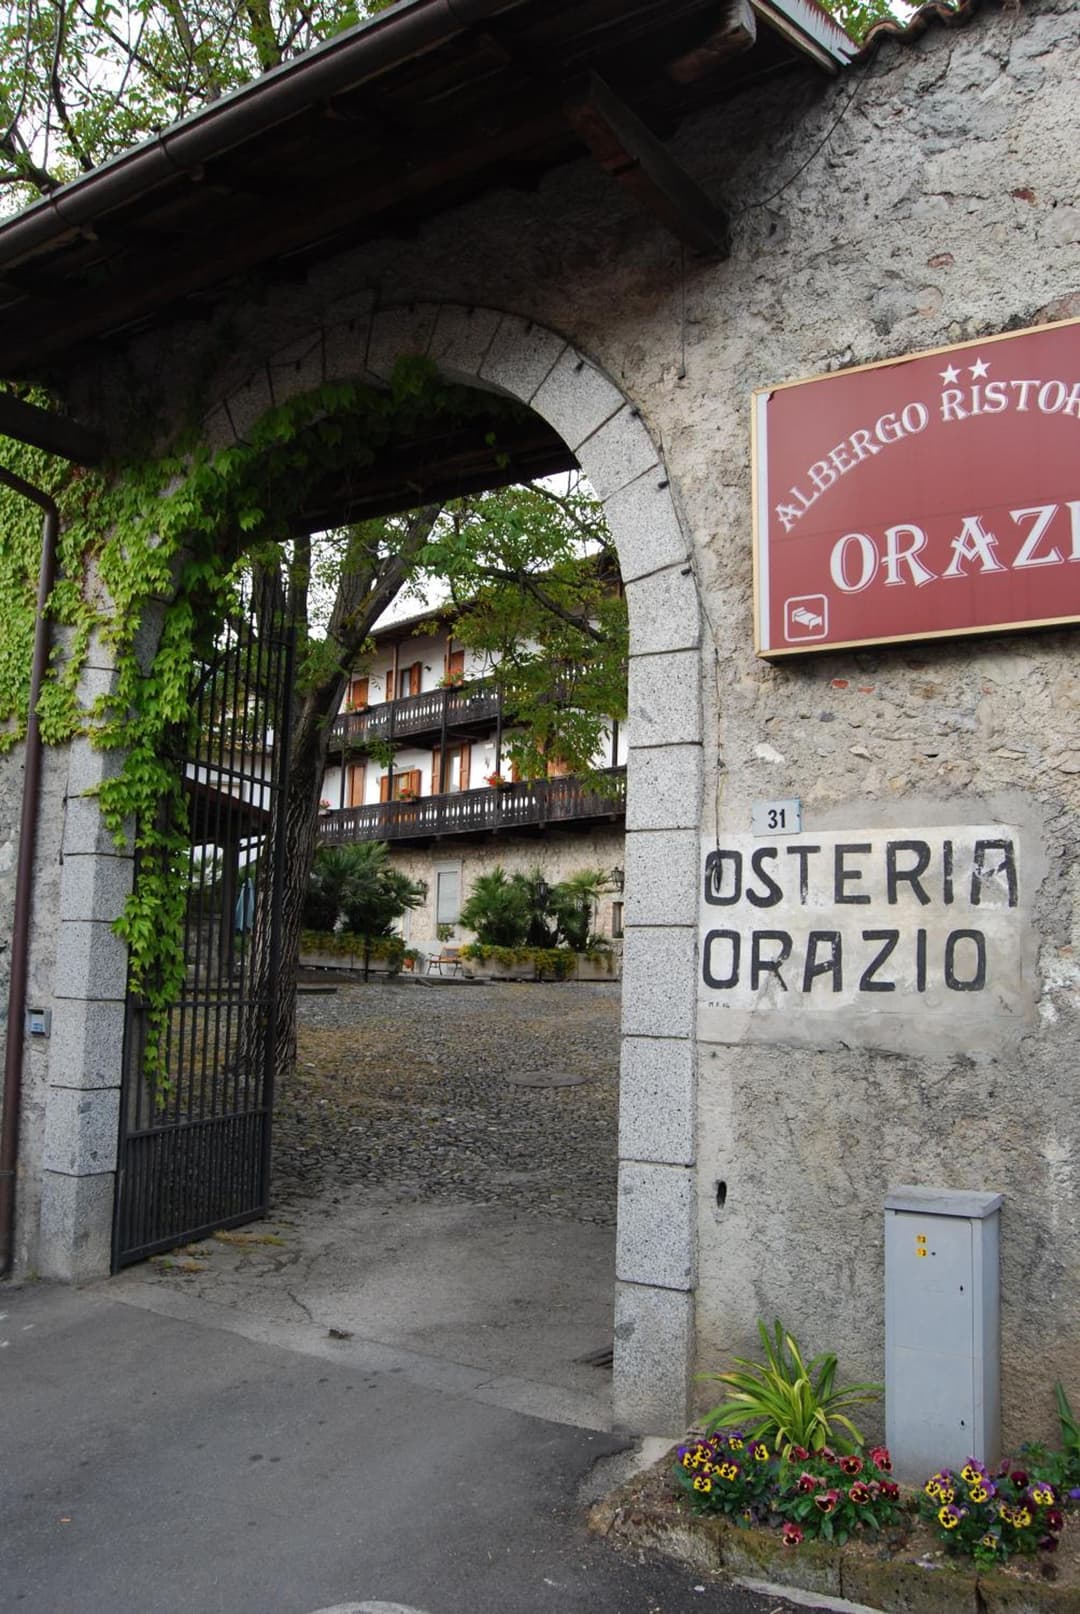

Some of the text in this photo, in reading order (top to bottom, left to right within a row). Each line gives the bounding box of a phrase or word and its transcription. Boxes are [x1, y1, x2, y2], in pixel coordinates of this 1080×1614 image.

[775, 402, 928, 533] ALBERGO
[767, 808, 786, 829] 31
[704, 839, 1019, 909] OSTERIA
[702, 928, 987, 993] ORAZIO
